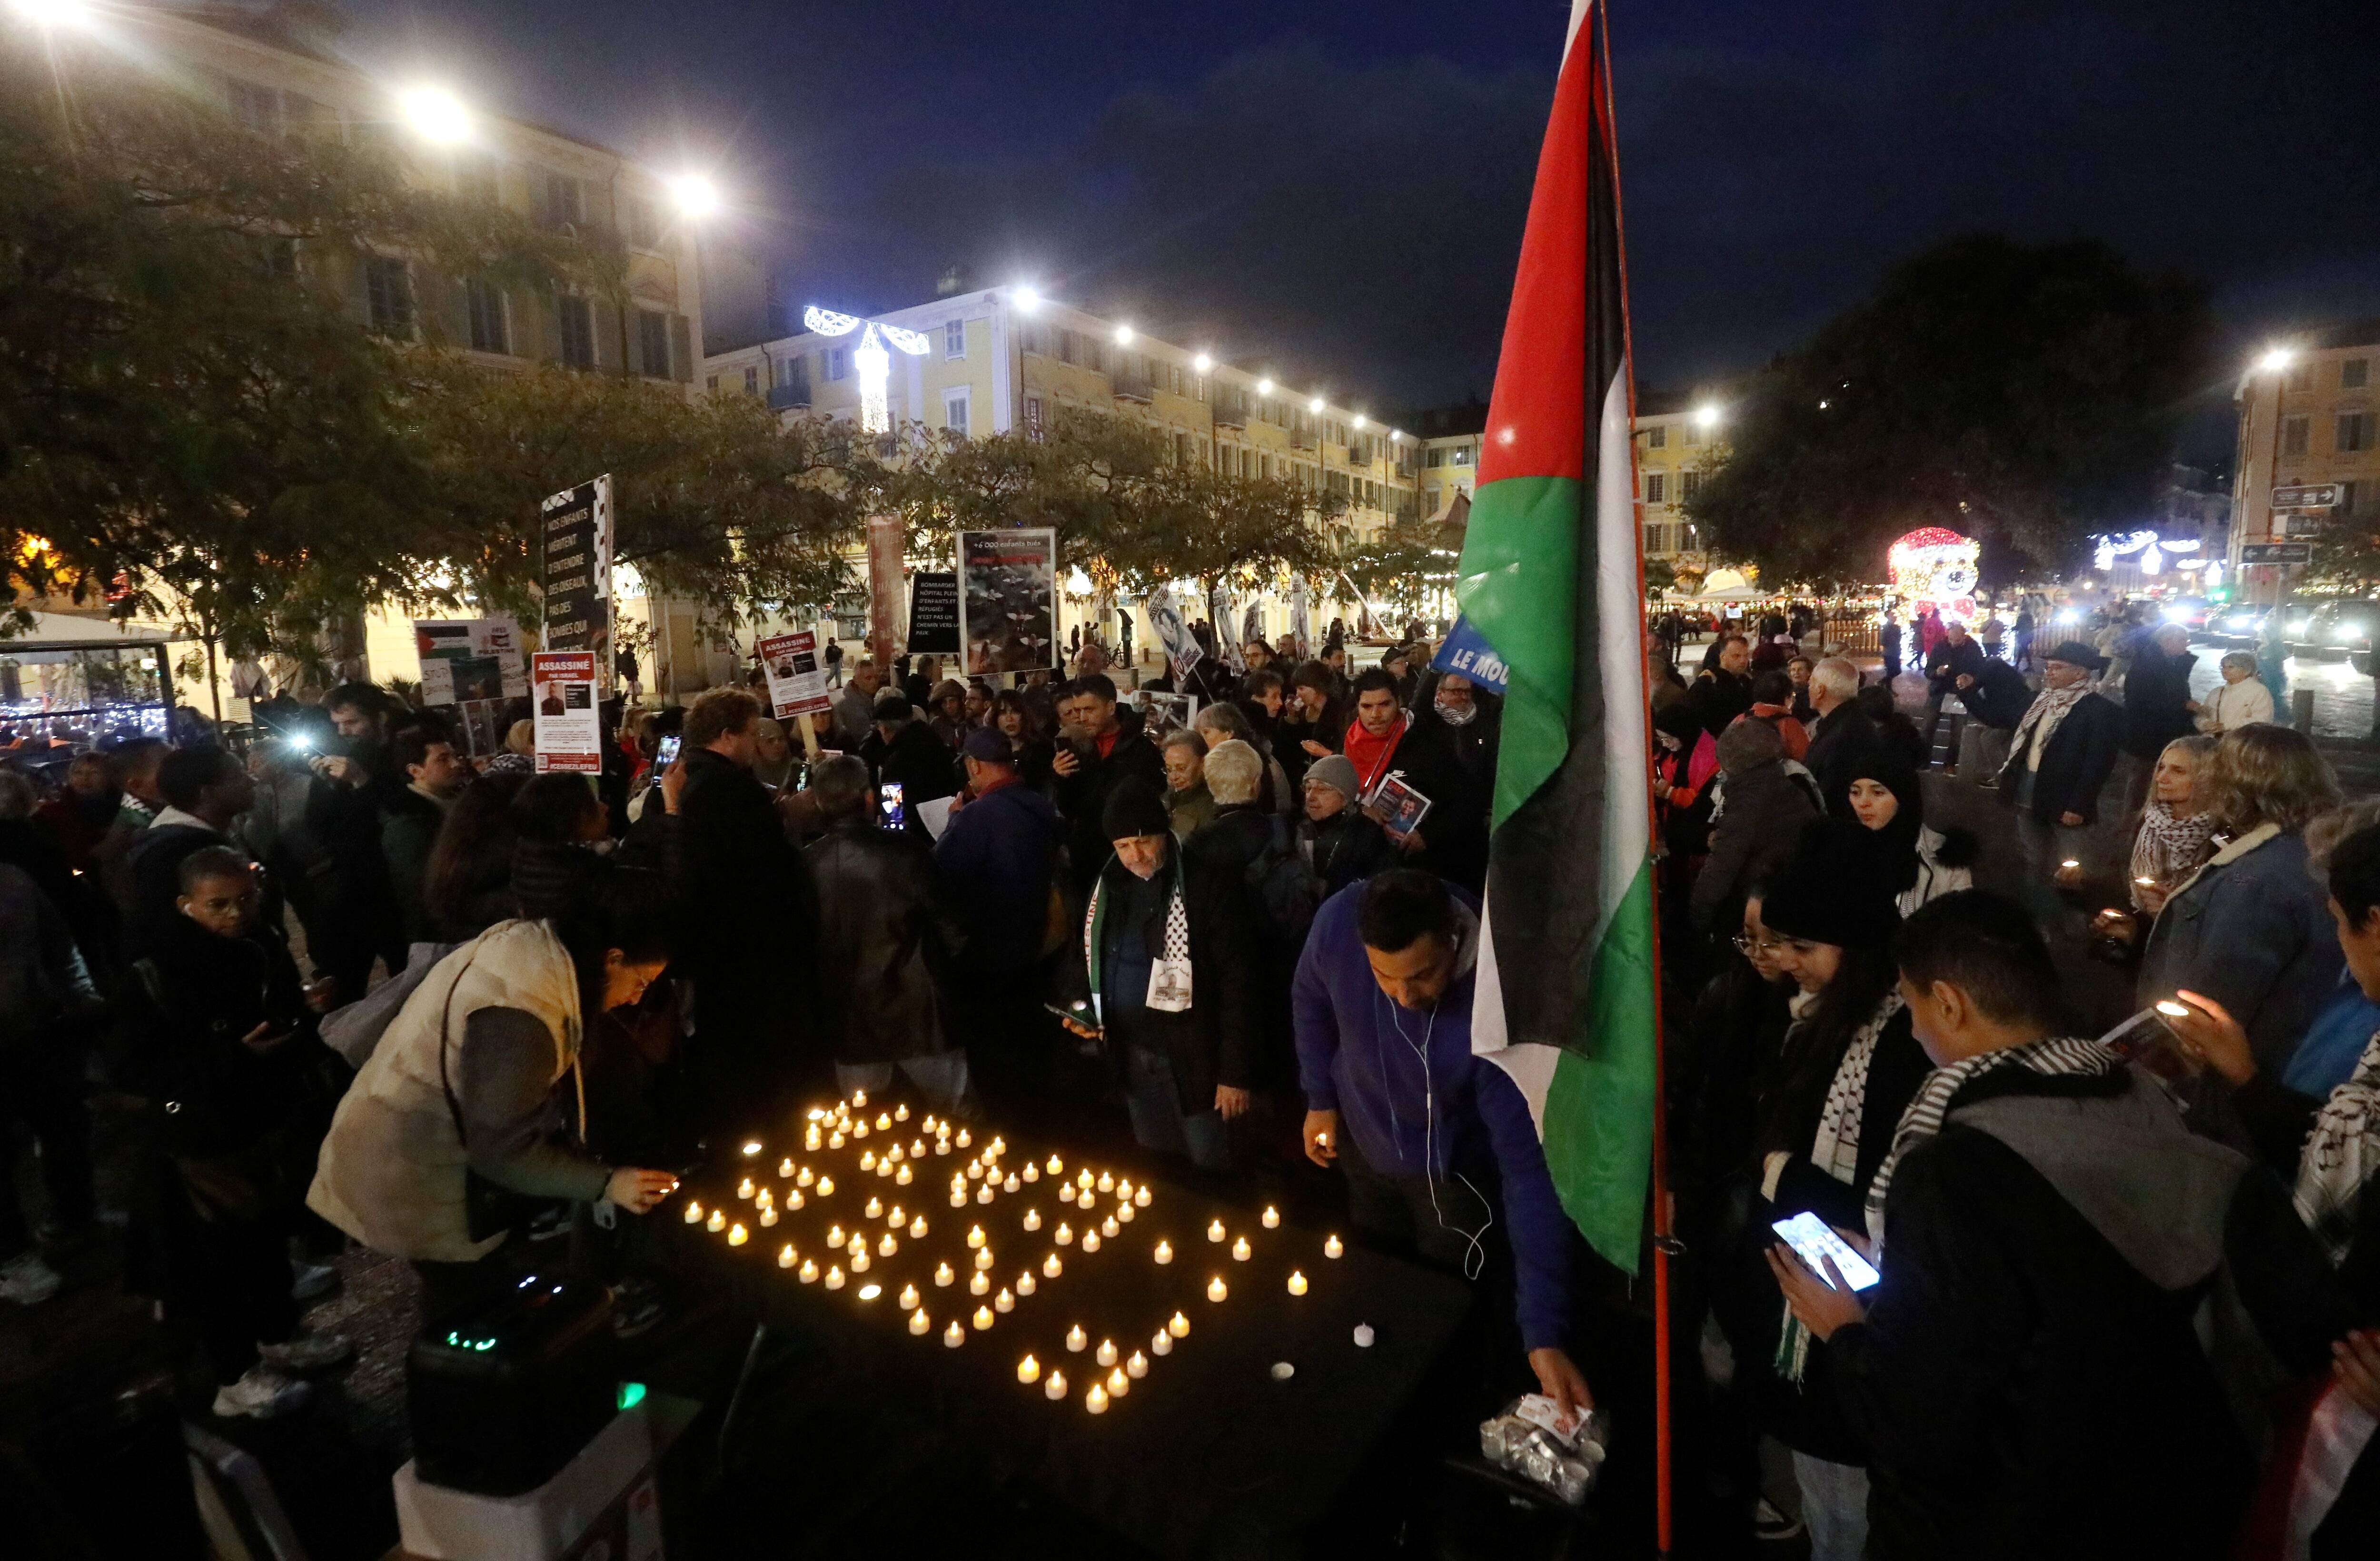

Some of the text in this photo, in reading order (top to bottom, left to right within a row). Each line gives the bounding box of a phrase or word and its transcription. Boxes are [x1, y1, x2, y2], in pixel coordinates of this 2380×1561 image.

[548, 508, 588, 532] NOS ENFANTS
[548, 534, 577, 553] MÉRITENT
[1000, 539, 1025, 547] enfants
[548, 583, 559, 595] DES
[549, 601, 571, 617] PAS DES
[574, 620, 587, 634] QUI
[538, 658, 590, 671] ASSASSINÉ
[1450, 648, 1475, 670] LE
